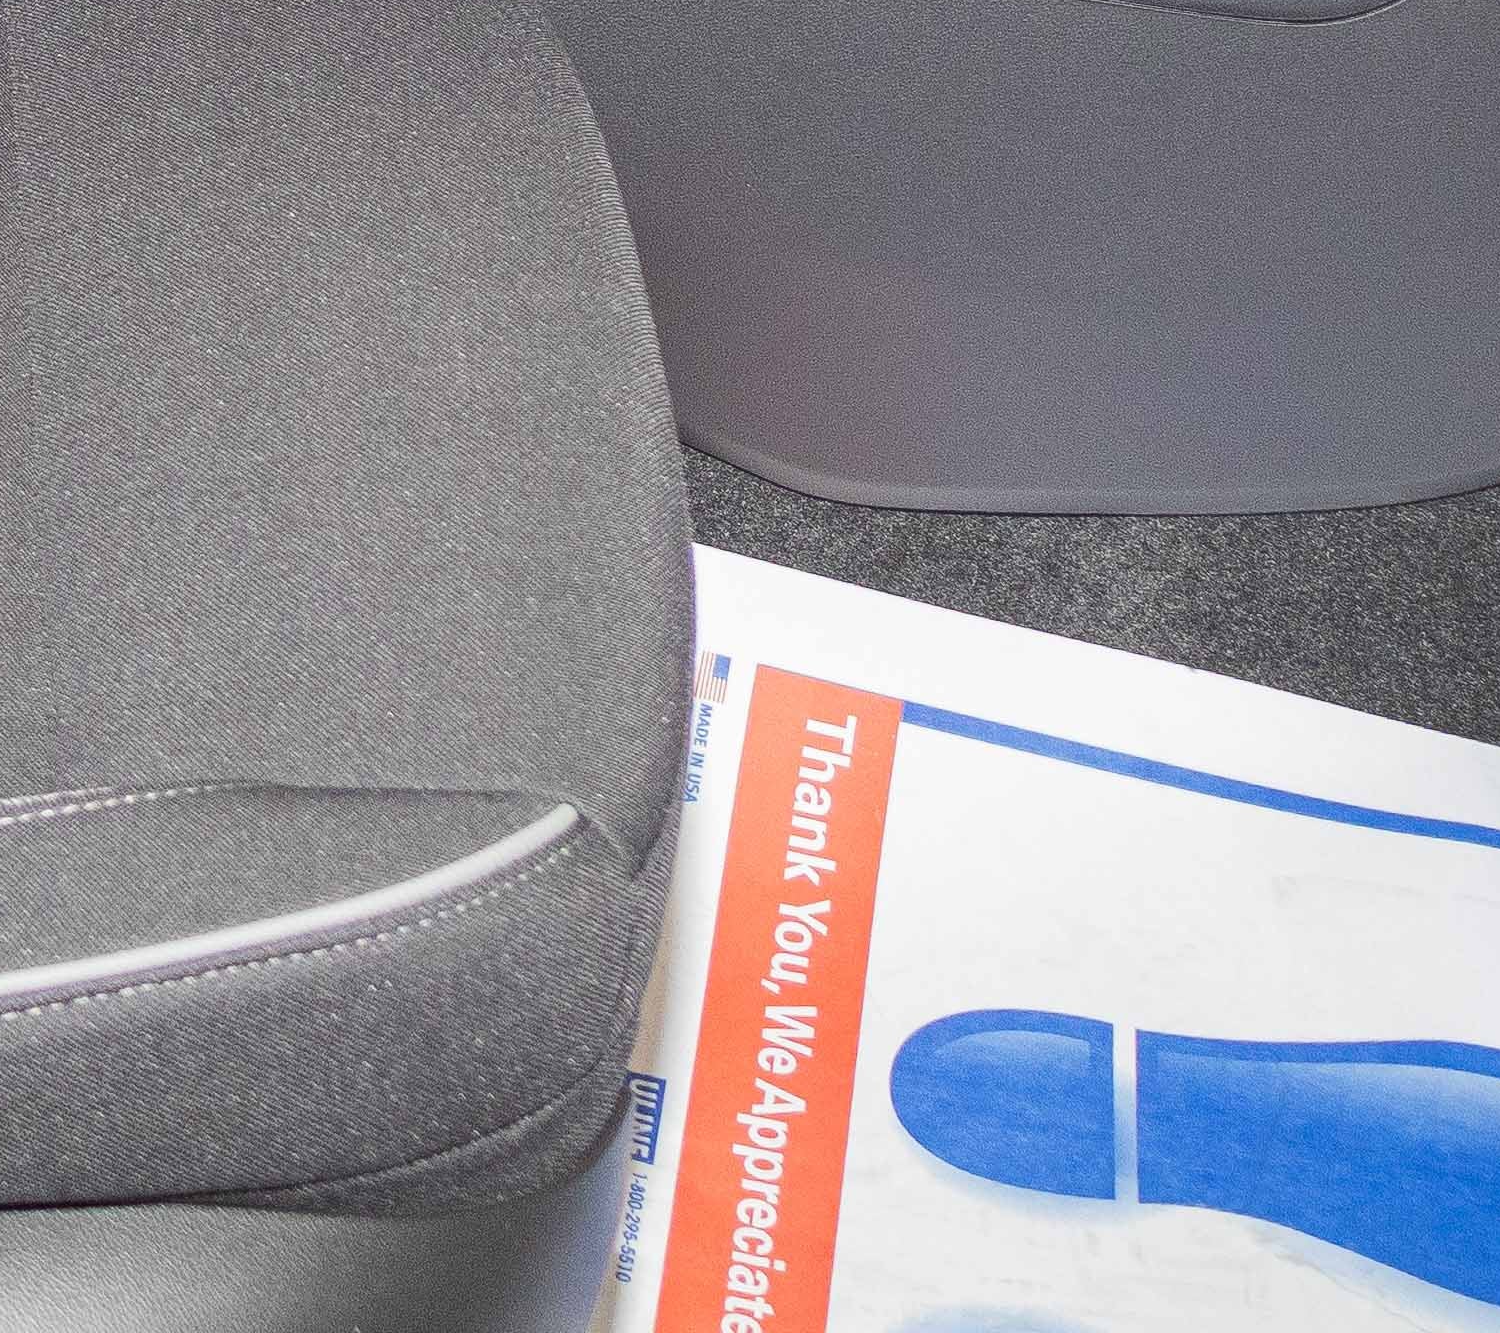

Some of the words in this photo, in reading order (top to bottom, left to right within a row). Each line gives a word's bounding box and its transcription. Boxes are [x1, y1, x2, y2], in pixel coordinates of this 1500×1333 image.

[689, 752, 705, 768] IN
[694, 703, 713, 748] MADE
[683, 774, 702, 803] USA
[782, 714, 858, 886] Thank
[760, 900, 829, 995] You,
[757, 1004, 818, 1076] We
[615, 1172, 648, 1284] 1-800-295-5510
[720, 1077, 808, 1333] Appreciate
